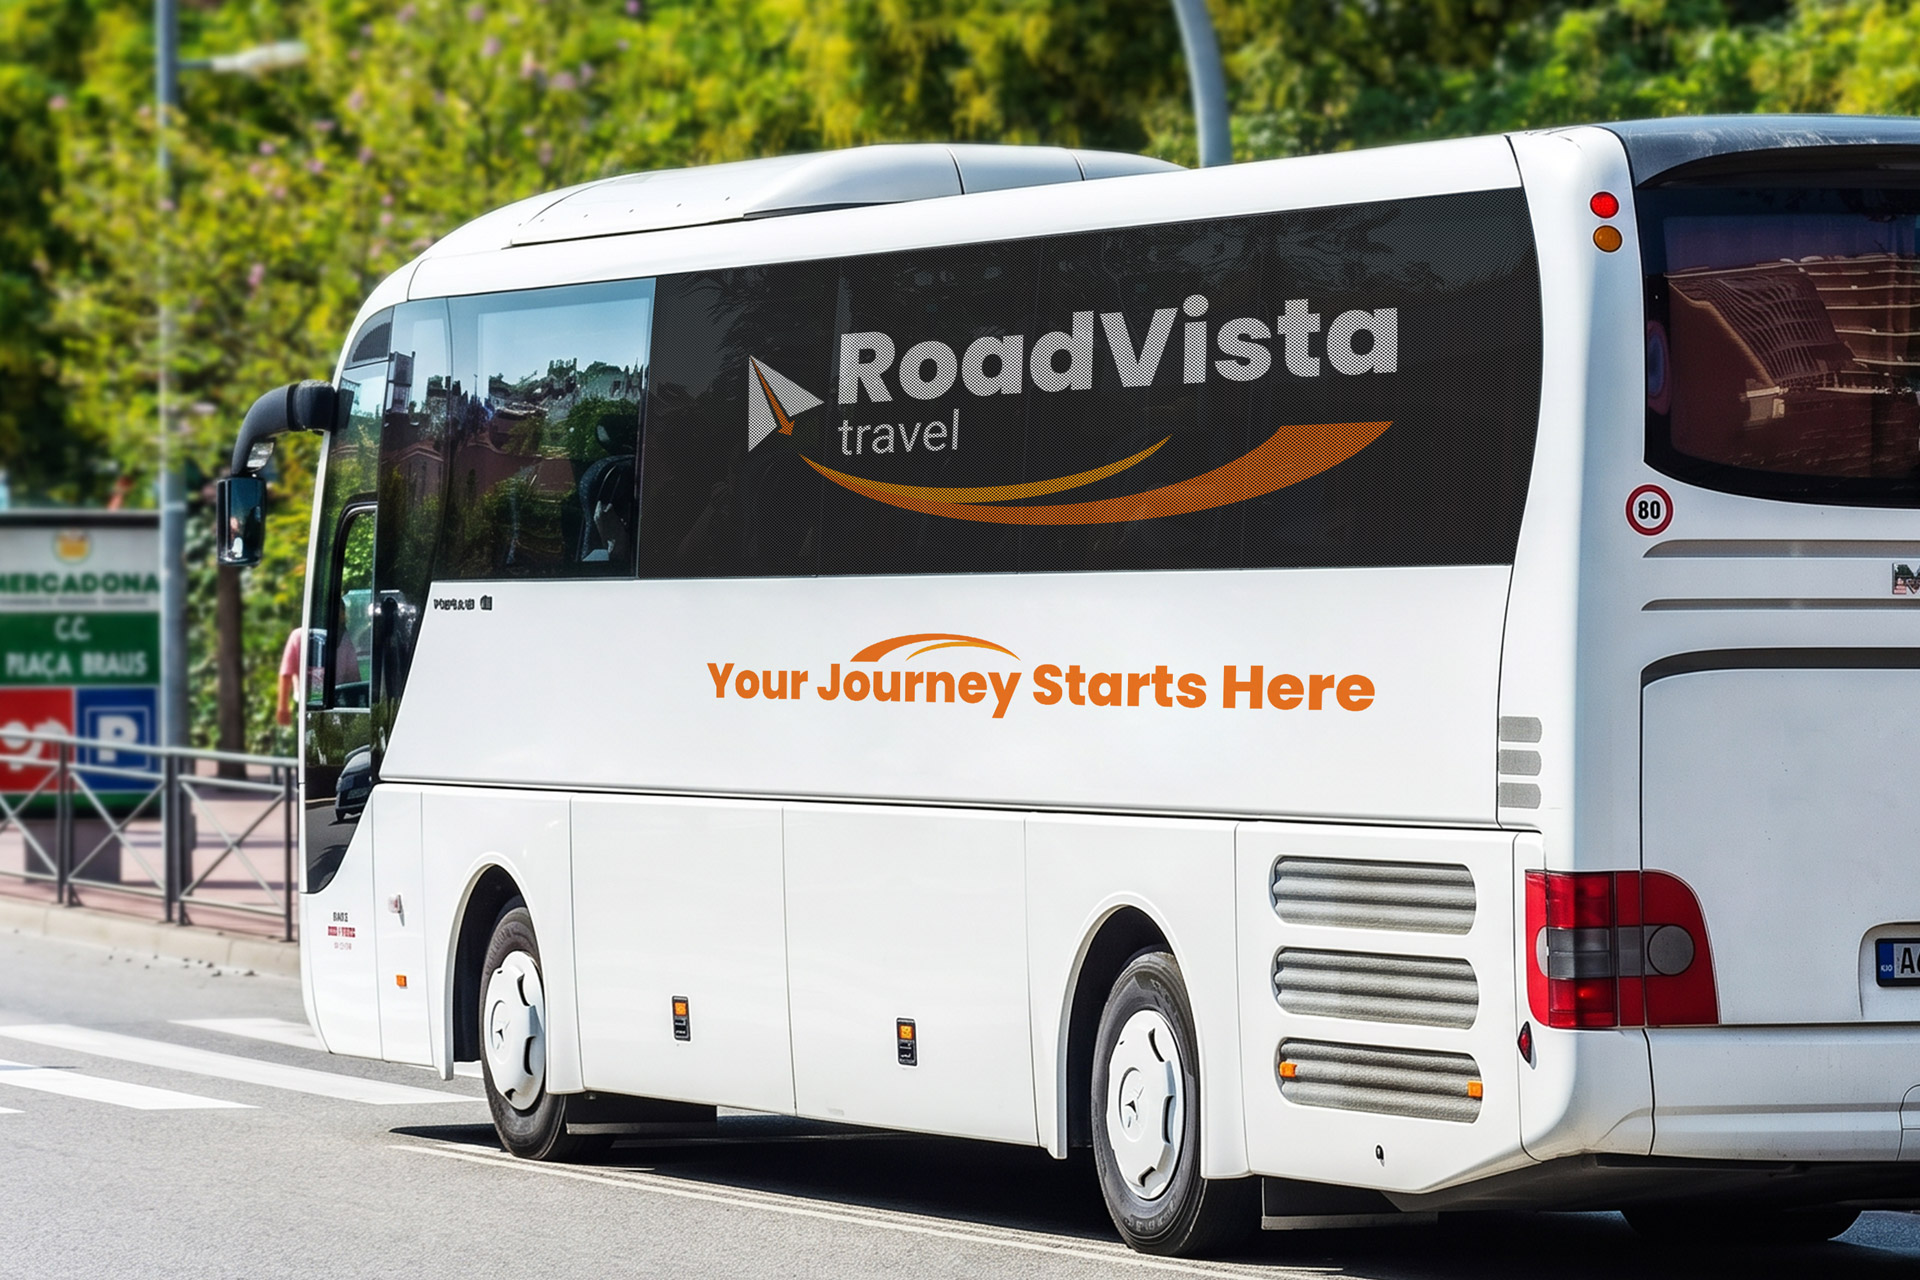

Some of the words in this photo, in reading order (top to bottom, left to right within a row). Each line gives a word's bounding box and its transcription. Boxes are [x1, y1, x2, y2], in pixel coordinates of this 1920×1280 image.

[838, 294, 1399, 405] RoadVista
[838, 409, 961, 456] travel
[1638, 500, 1661, 519] 80
[707, 663, 808, 700] Your
[817, 664, 1022, 719] Journey
[1033, 664, 1206, 708] Starts
[1223, 665, 1375, 711] Here
[1901, 947, 1920, 974] A
